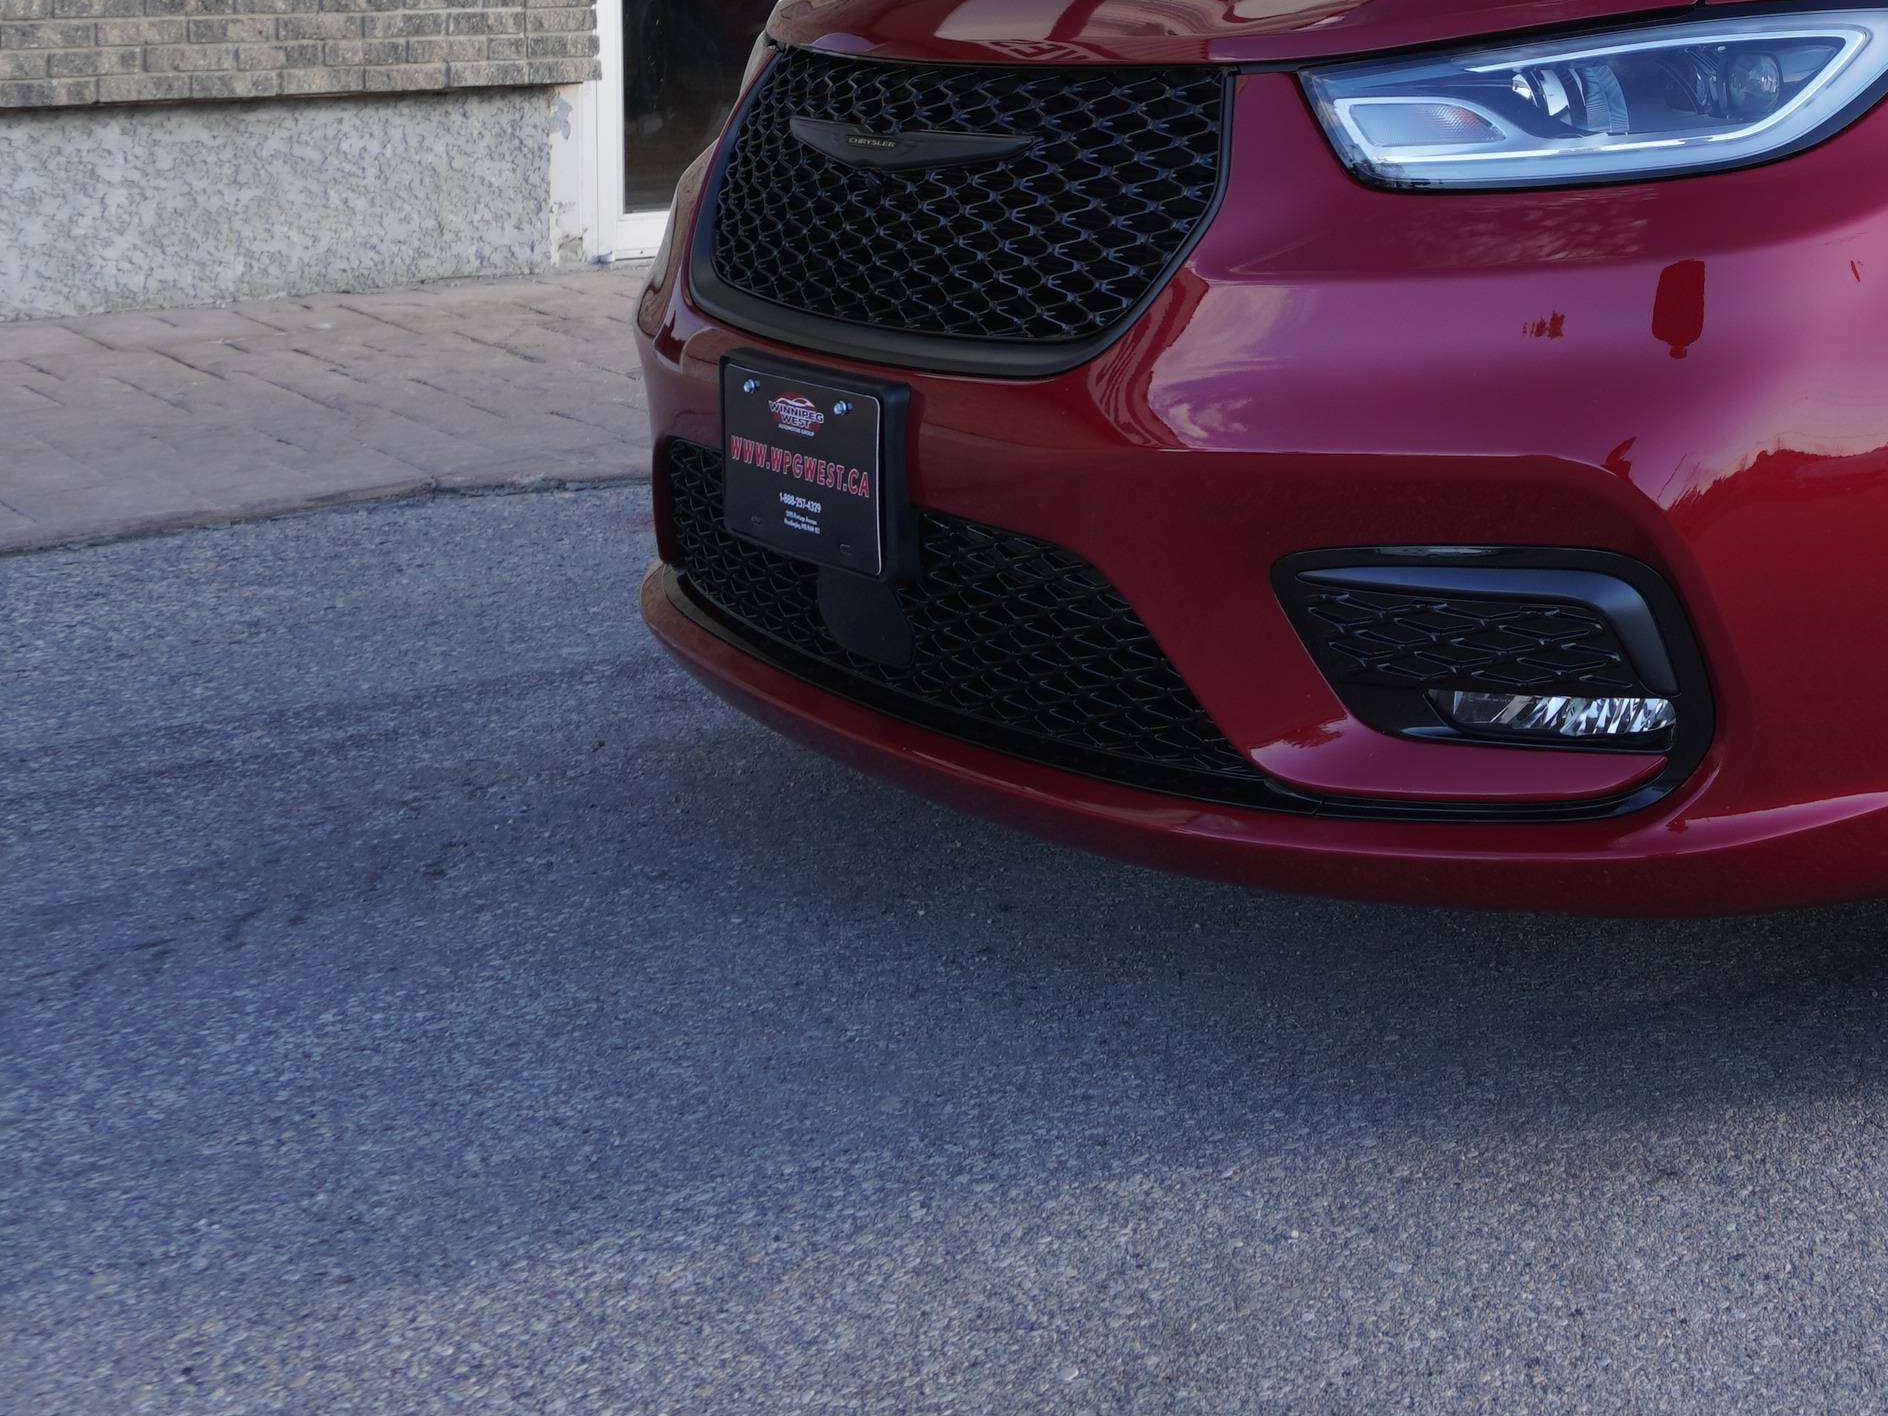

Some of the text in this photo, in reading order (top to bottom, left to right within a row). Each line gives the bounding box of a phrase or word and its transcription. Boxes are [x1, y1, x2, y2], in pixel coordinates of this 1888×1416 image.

[768, 400, 824, 424] WINNIPEG
[781, 412, 811, 429] WEST
[730, 434, 870, 498] WWW.WPGWEST.CA
